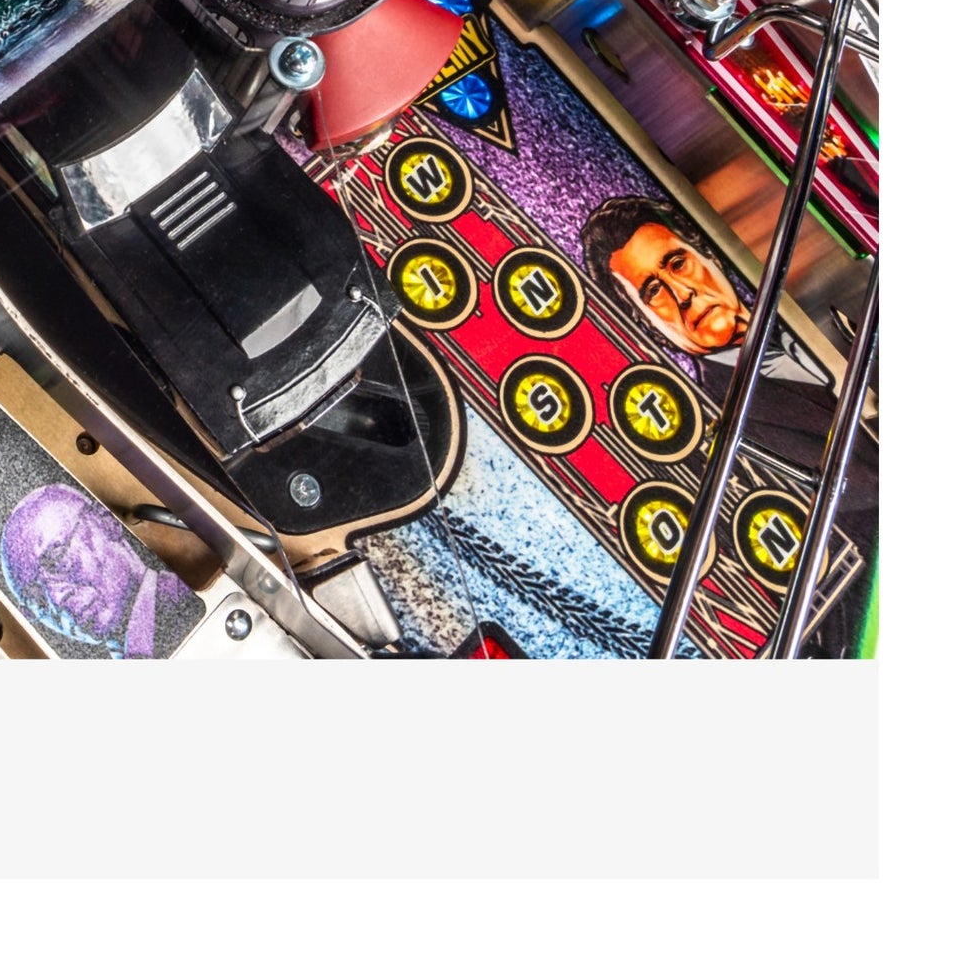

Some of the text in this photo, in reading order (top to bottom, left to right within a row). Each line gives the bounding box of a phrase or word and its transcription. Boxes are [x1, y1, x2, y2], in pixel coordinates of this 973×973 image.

[404, 153, 447, 202] W
[417, 264, 558, 316] I N
[527, 382, 671, 434] S T
[648, 508, 800, 568] O N
